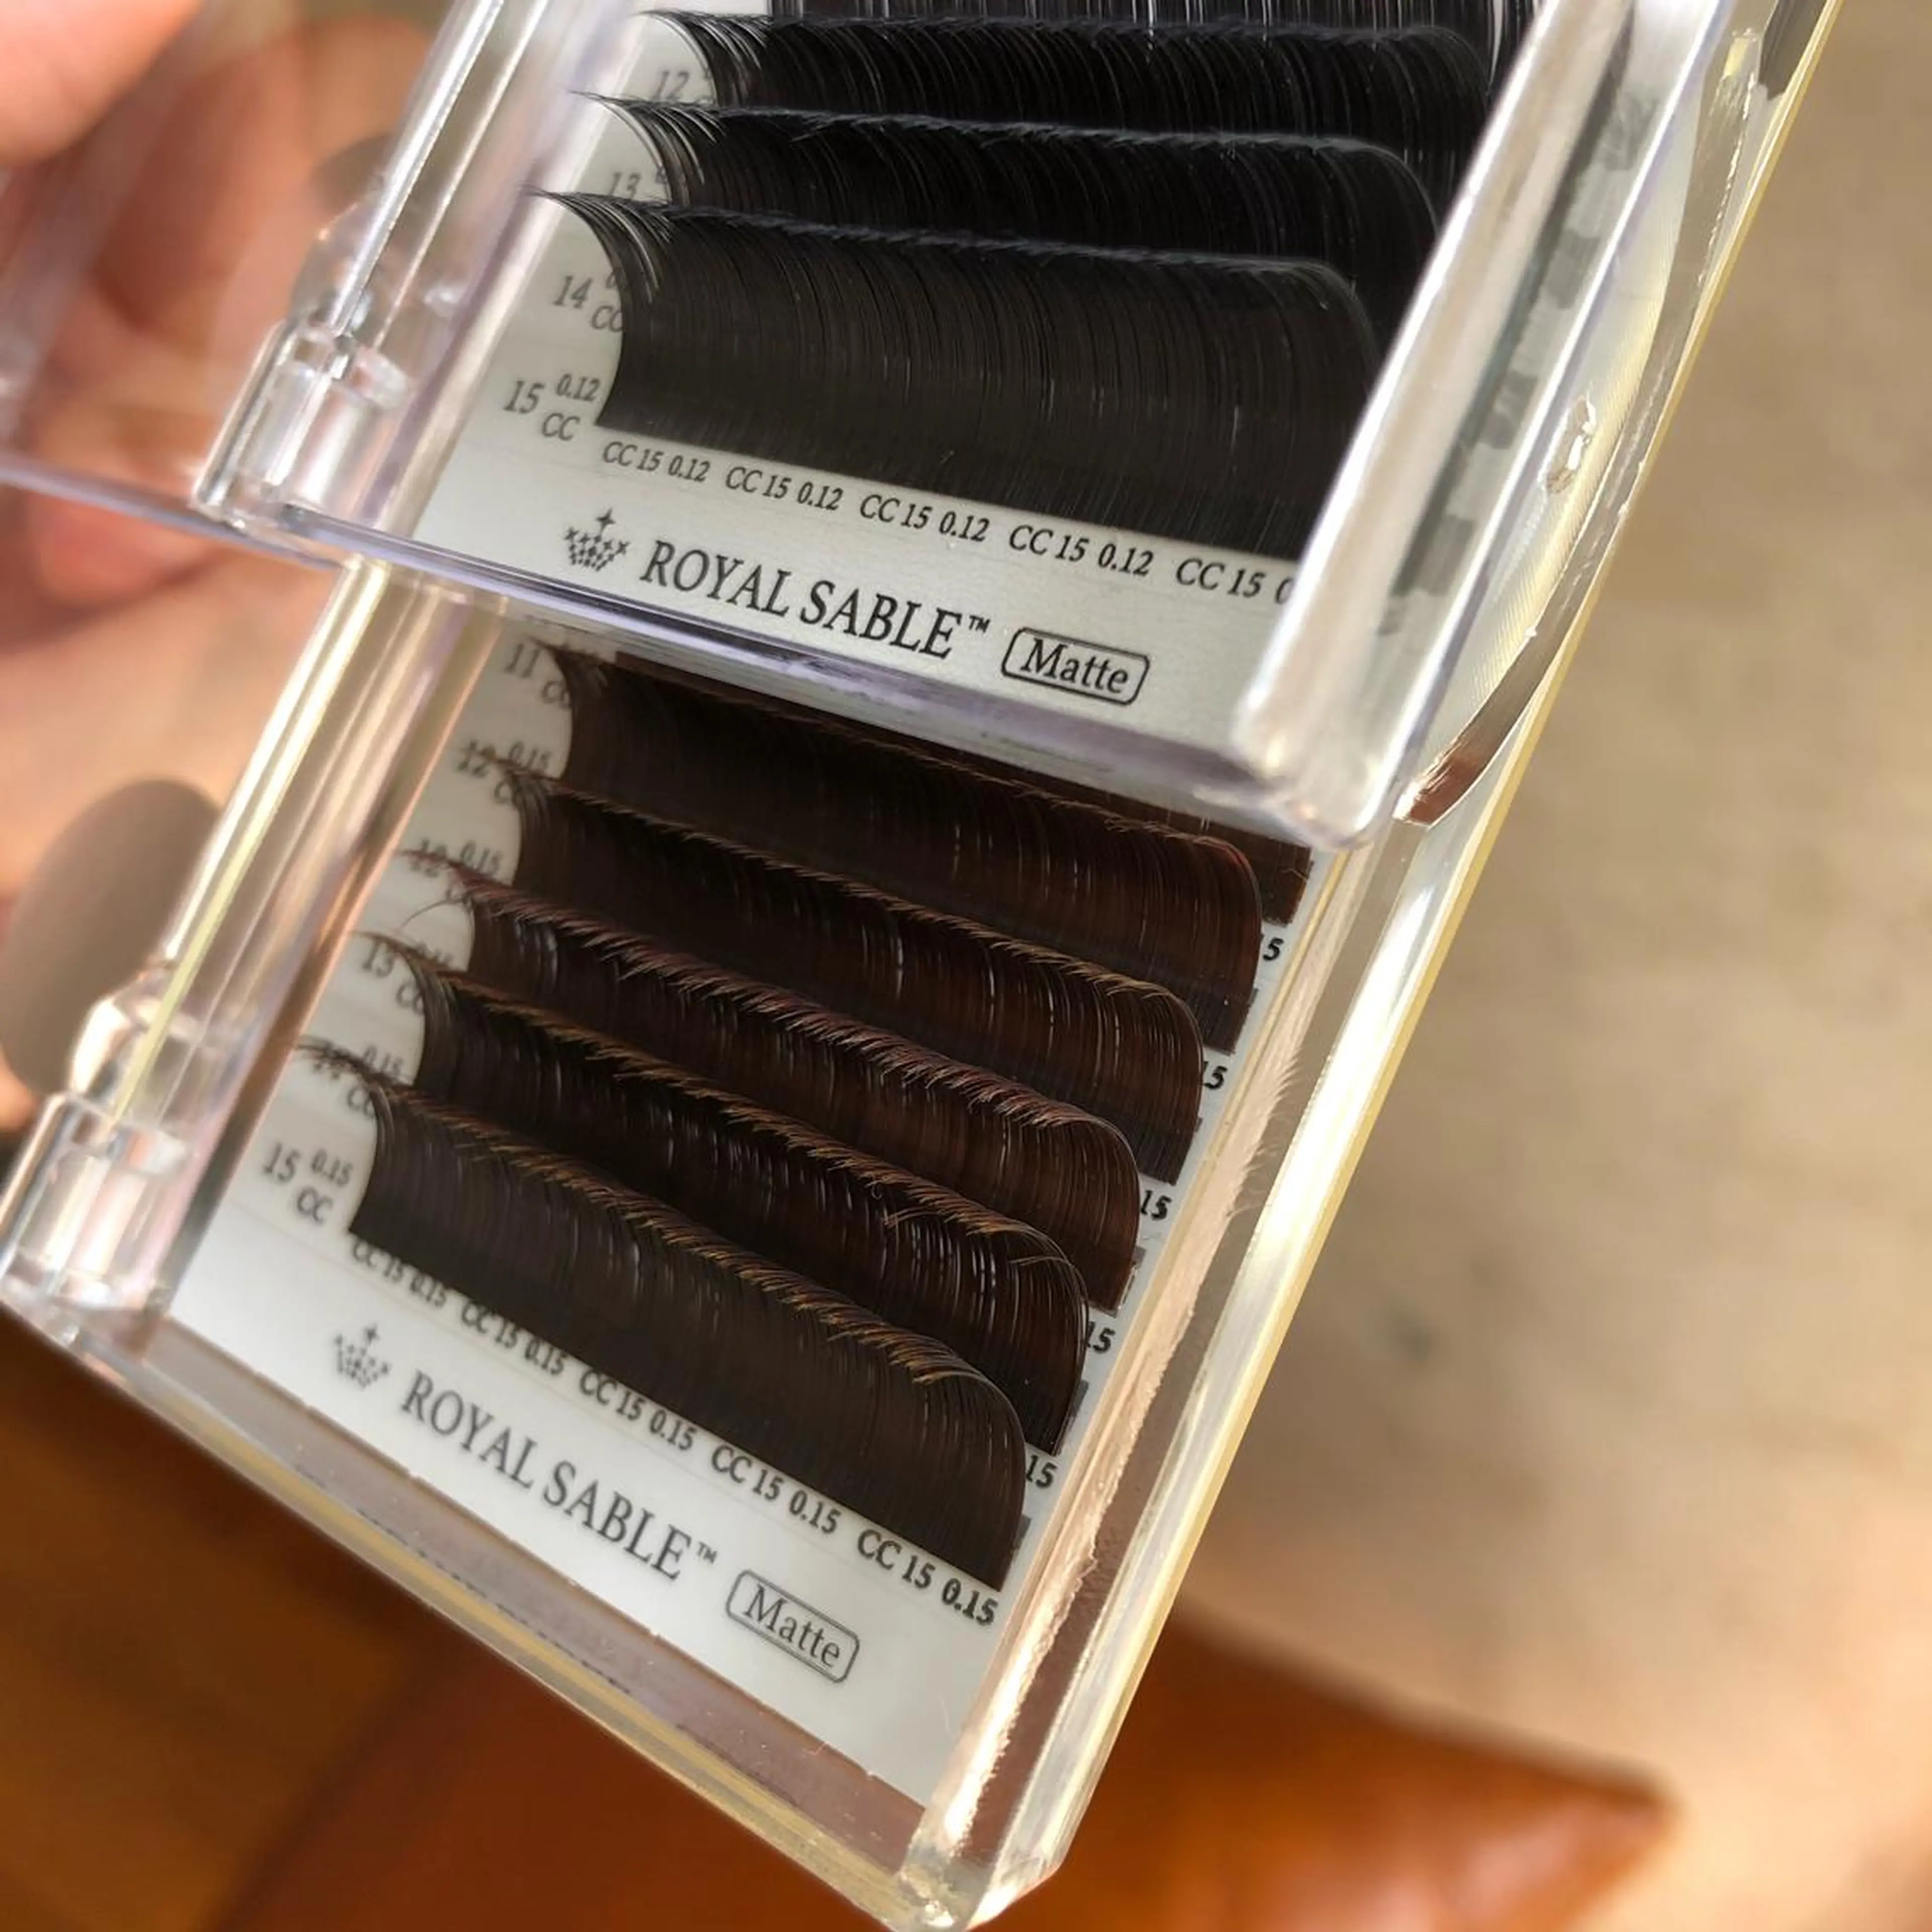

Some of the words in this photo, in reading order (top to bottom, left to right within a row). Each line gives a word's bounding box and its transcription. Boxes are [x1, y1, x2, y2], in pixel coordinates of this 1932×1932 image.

[553, 275, 593, 309] 14
[503, 380, 545, 414] 15
[556, 373, 601, 402] 0.12
[542, 413, 580, 440] CC
[602, 441, 637, 467] CC
[636, 449, 664, 472] 15
[668, 455, 711, 482] 0.12
[726, 466, 763, 493] CC
[762, 475, 792, 500] 15
[797, 481, 844, 511] 0.12
[859, 494, 901, 524] CC
[901, 504, 933, 530] 15
[938, 511, 991, 542] 0.12
[1009, 525, 1054, 555] CC
[1055, 535, 1091, 562] 15
[1097, 543, 1155, 578] 0.12
[1175, 557, 1225, 591] CC
[1227, 569, 1266, 599] 15
[639, 540, 791, 617] ROYAL
[504, 643, 541, 678] 11
[1020, 637, 1130, 694] Matte
[263, 1143, 300, 1182] 15
[310, 1148, 354, 1187] 0.15
[297, 1185, 333, 1225] CC
[400, 1369, 538, 1489] ROYAL
[461, 1300, 496, 1334] CC
[524, 1336, 568, 1376] 0.15
[580, 1367, 618, 1405] CC
[616, 1389, 642, 1421] 15
[649, 1409, 698, 1451] 0.15
[711, 1444, 752, 1484] CC
[752, 1469, 784, 1502] 15
[788, 1489, 842, 1535] 0.15
[857, 1528, 902, 1571] CC
[901, 1555, 936, 1589] 15
[941, 1577, 999, 1626] 0.15
[745, 1585, 841, 1668] Matte
